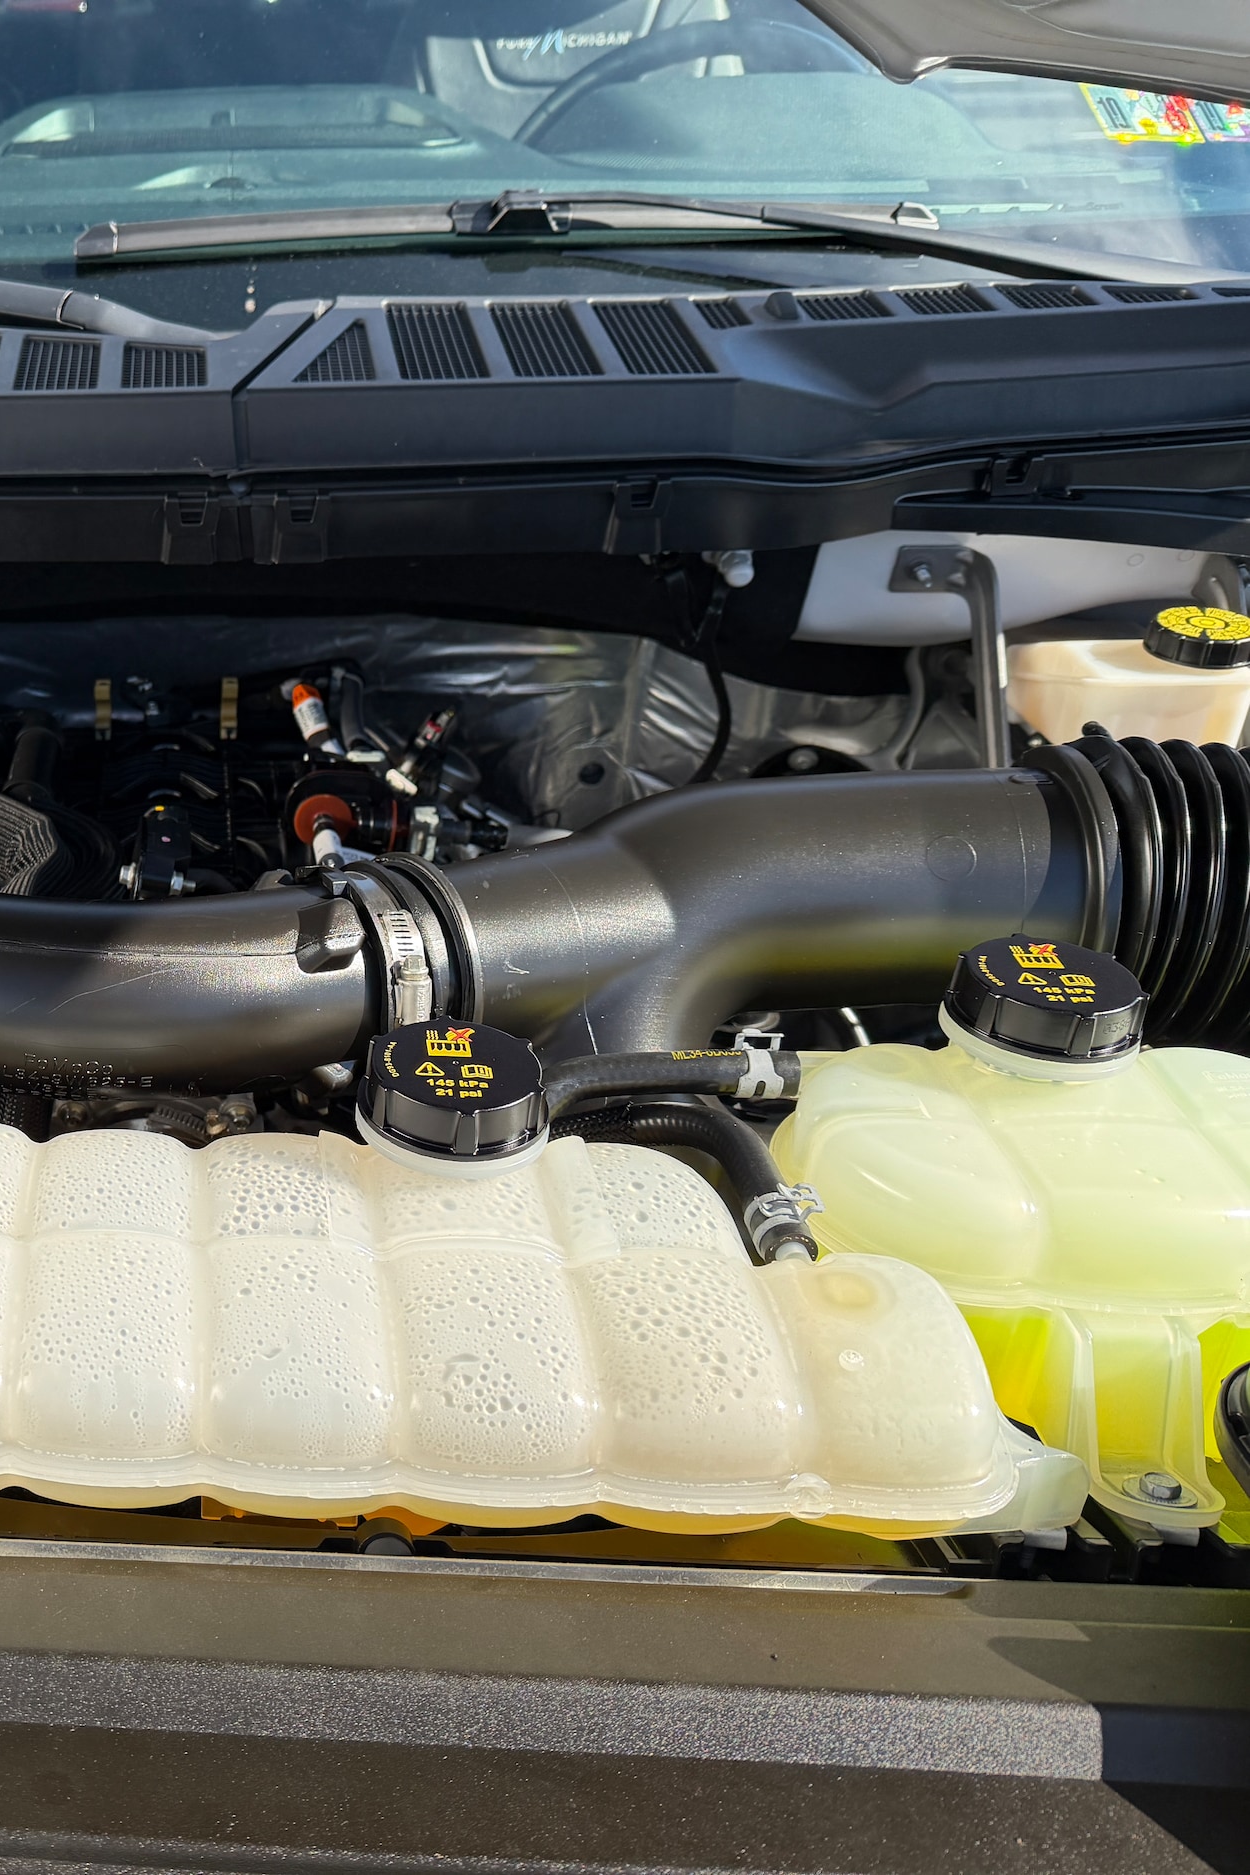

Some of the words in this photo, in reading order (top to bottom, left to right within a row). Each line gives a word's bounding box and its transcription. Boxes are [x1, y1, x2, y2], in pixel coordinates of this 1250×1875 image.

[1064, 987, 1096, 995] kPa
[1070, 995, 1095, 1003] psi
[426, 1079, 455, 1087] 145
[459, 1080, 489, 1088] kPa
[435, 1089, 453, 1097] 21
[459, 1089, 483, 1098] psi
